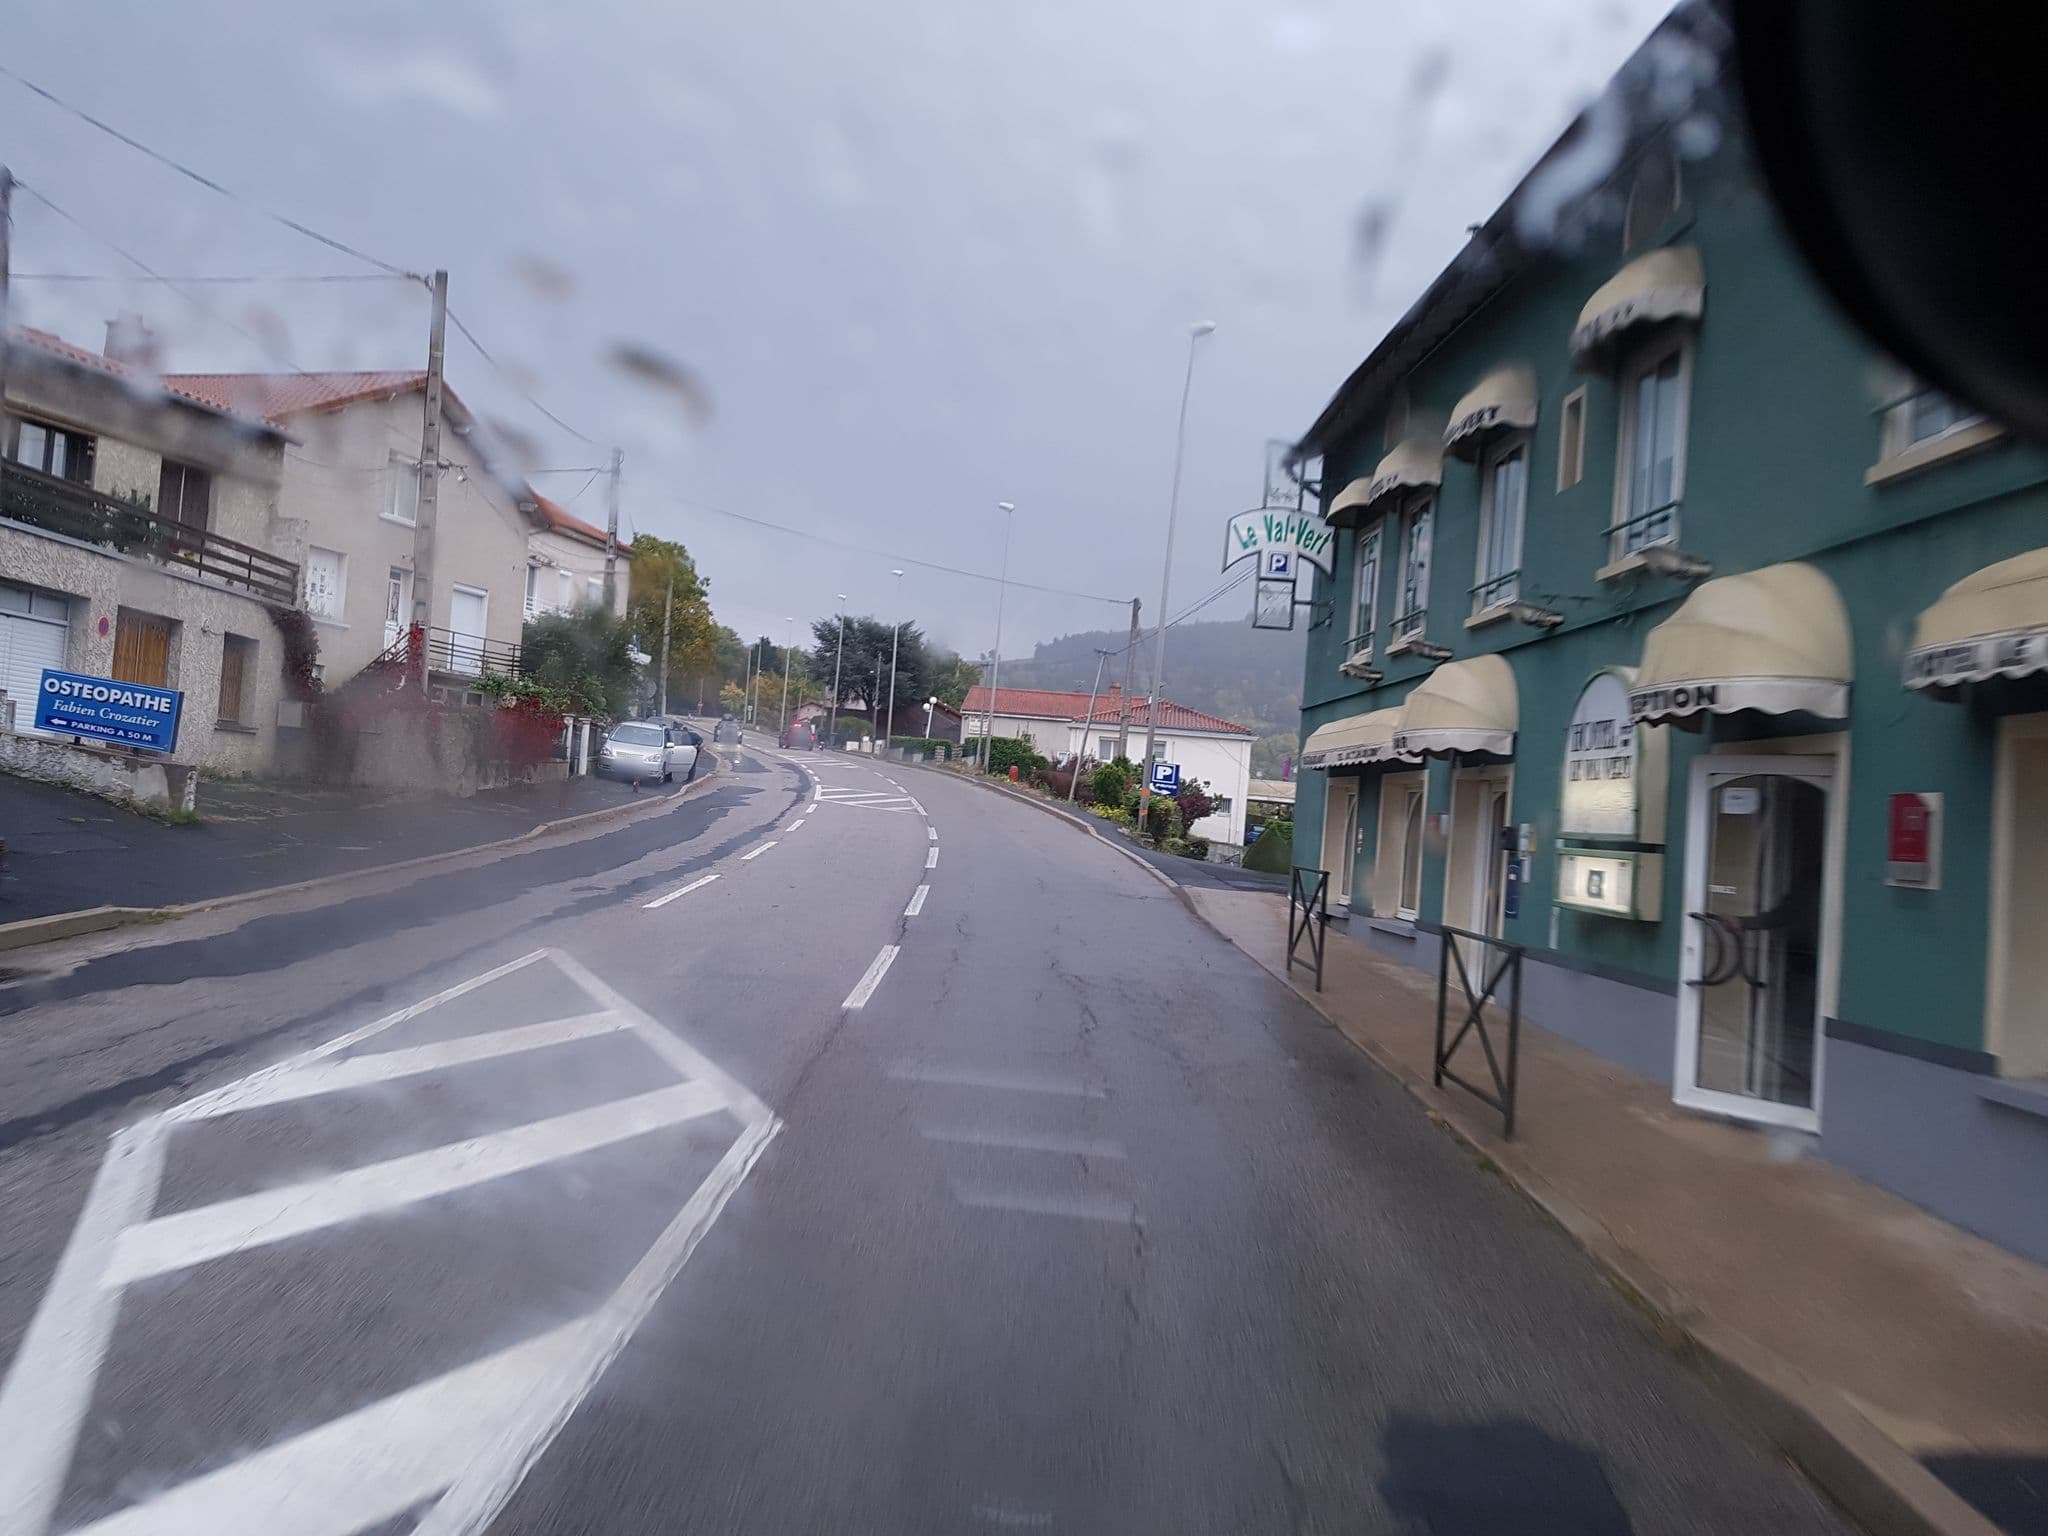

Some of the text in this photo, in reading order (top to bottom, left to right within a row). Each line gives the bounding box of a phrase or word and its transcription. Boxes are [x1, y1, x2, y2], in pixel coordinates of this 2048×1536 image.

[1233, 523, 1257, 550] Le
[1271, 555, 1285, 572] P
[44, 678, 172, 713] OSTEOPATHE
[52, 699, 160, 728] Fabien Crozatier
[70, 721, 153, 742] PARKING A 50 M
[1156, 766, 1173, 780] P
